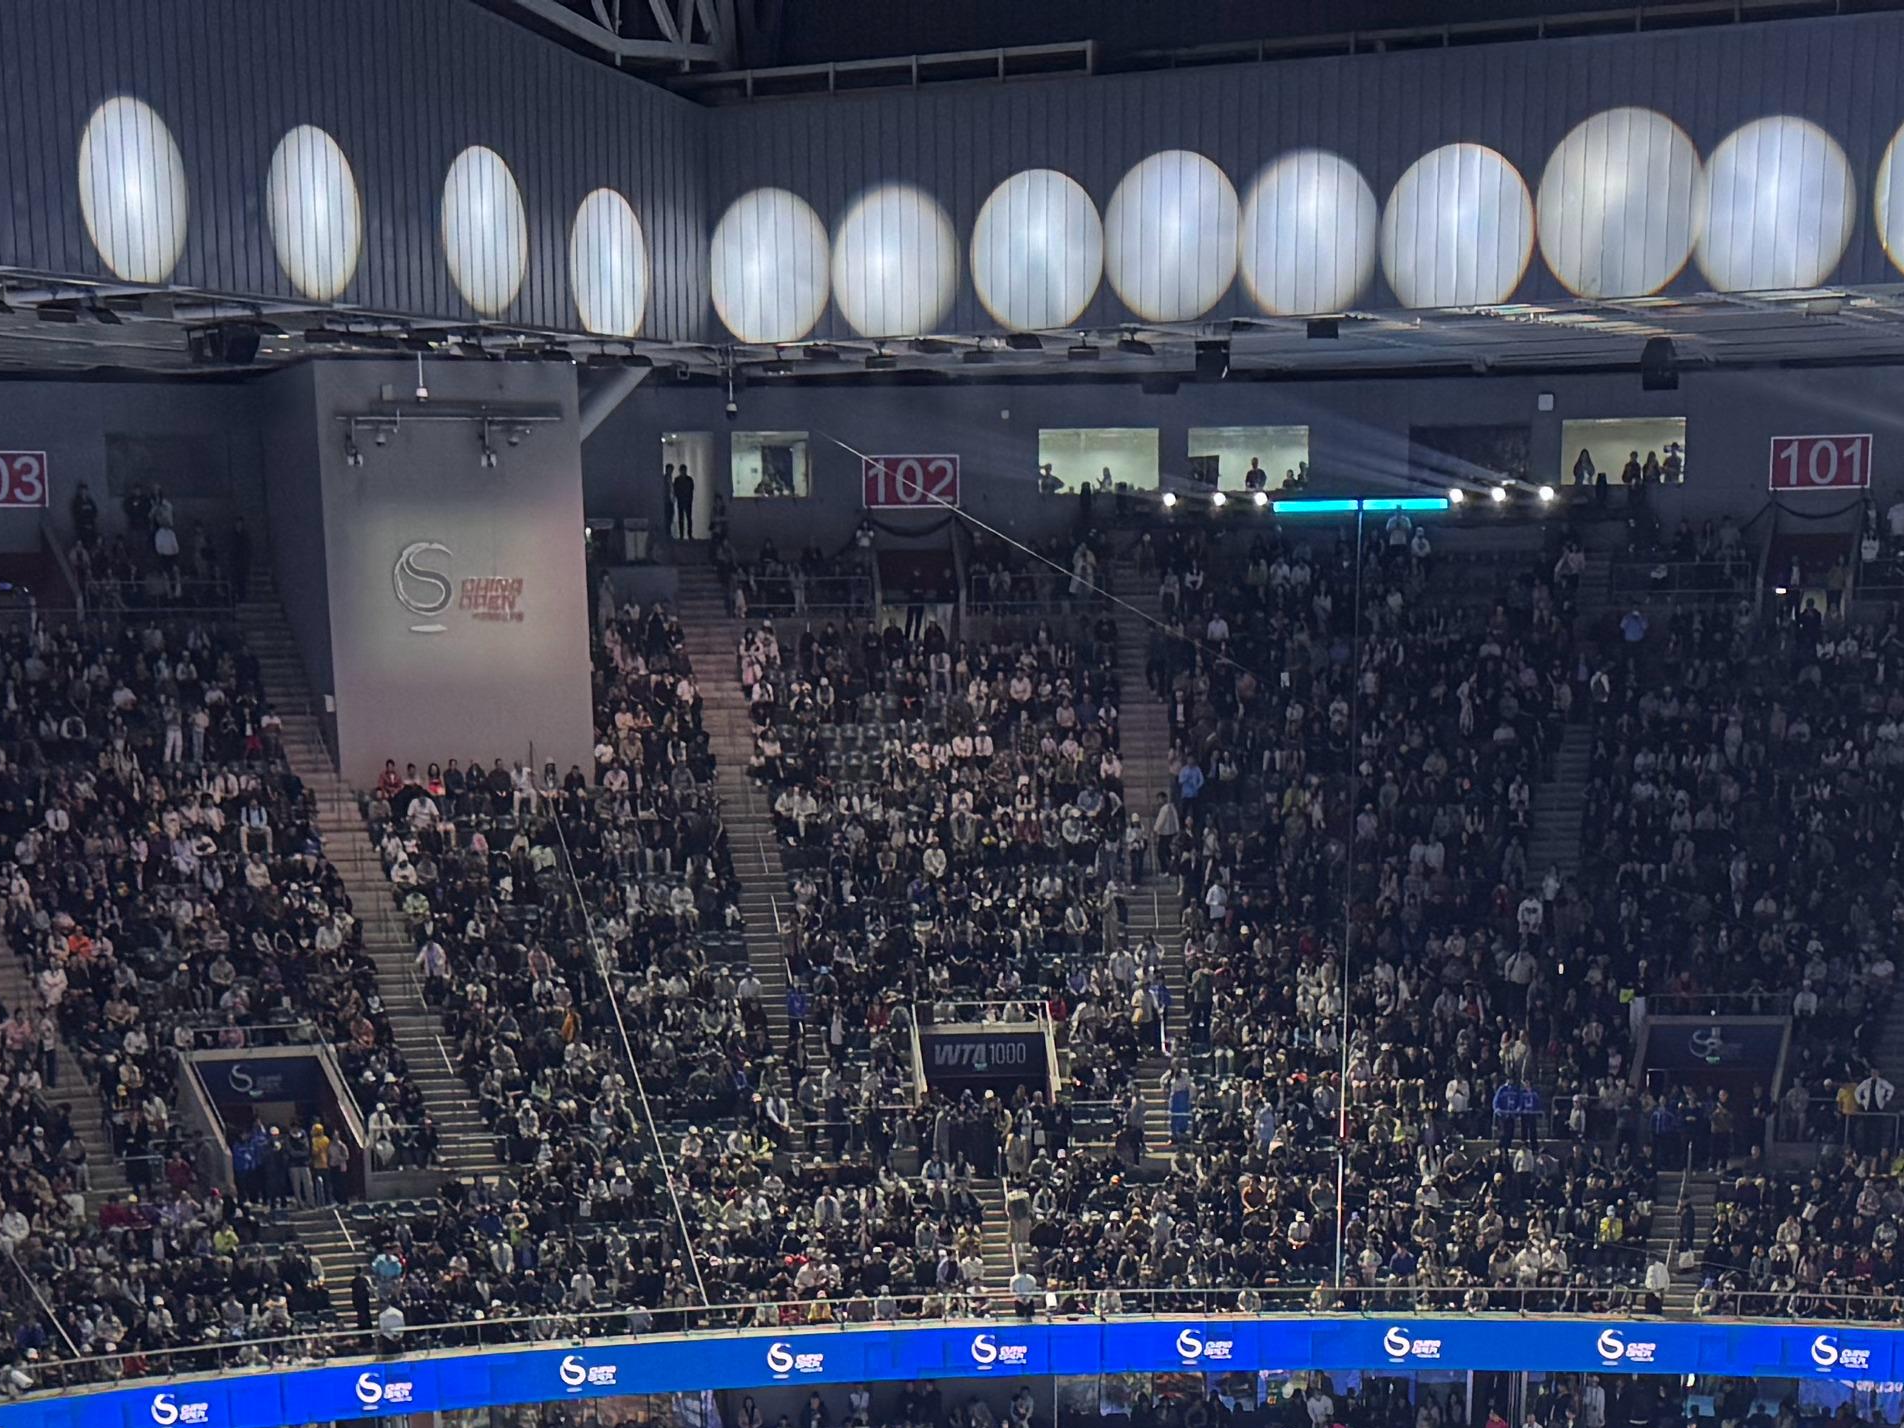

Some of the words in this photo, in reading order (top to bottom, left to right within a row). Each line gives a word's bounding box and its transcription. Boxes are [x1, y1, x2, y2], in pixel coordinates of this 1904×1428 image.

[868, 458, 954, 503] 102
[1780, 438, 1862, 485] 101
[988, 1042, 1027, 1065] 1000
